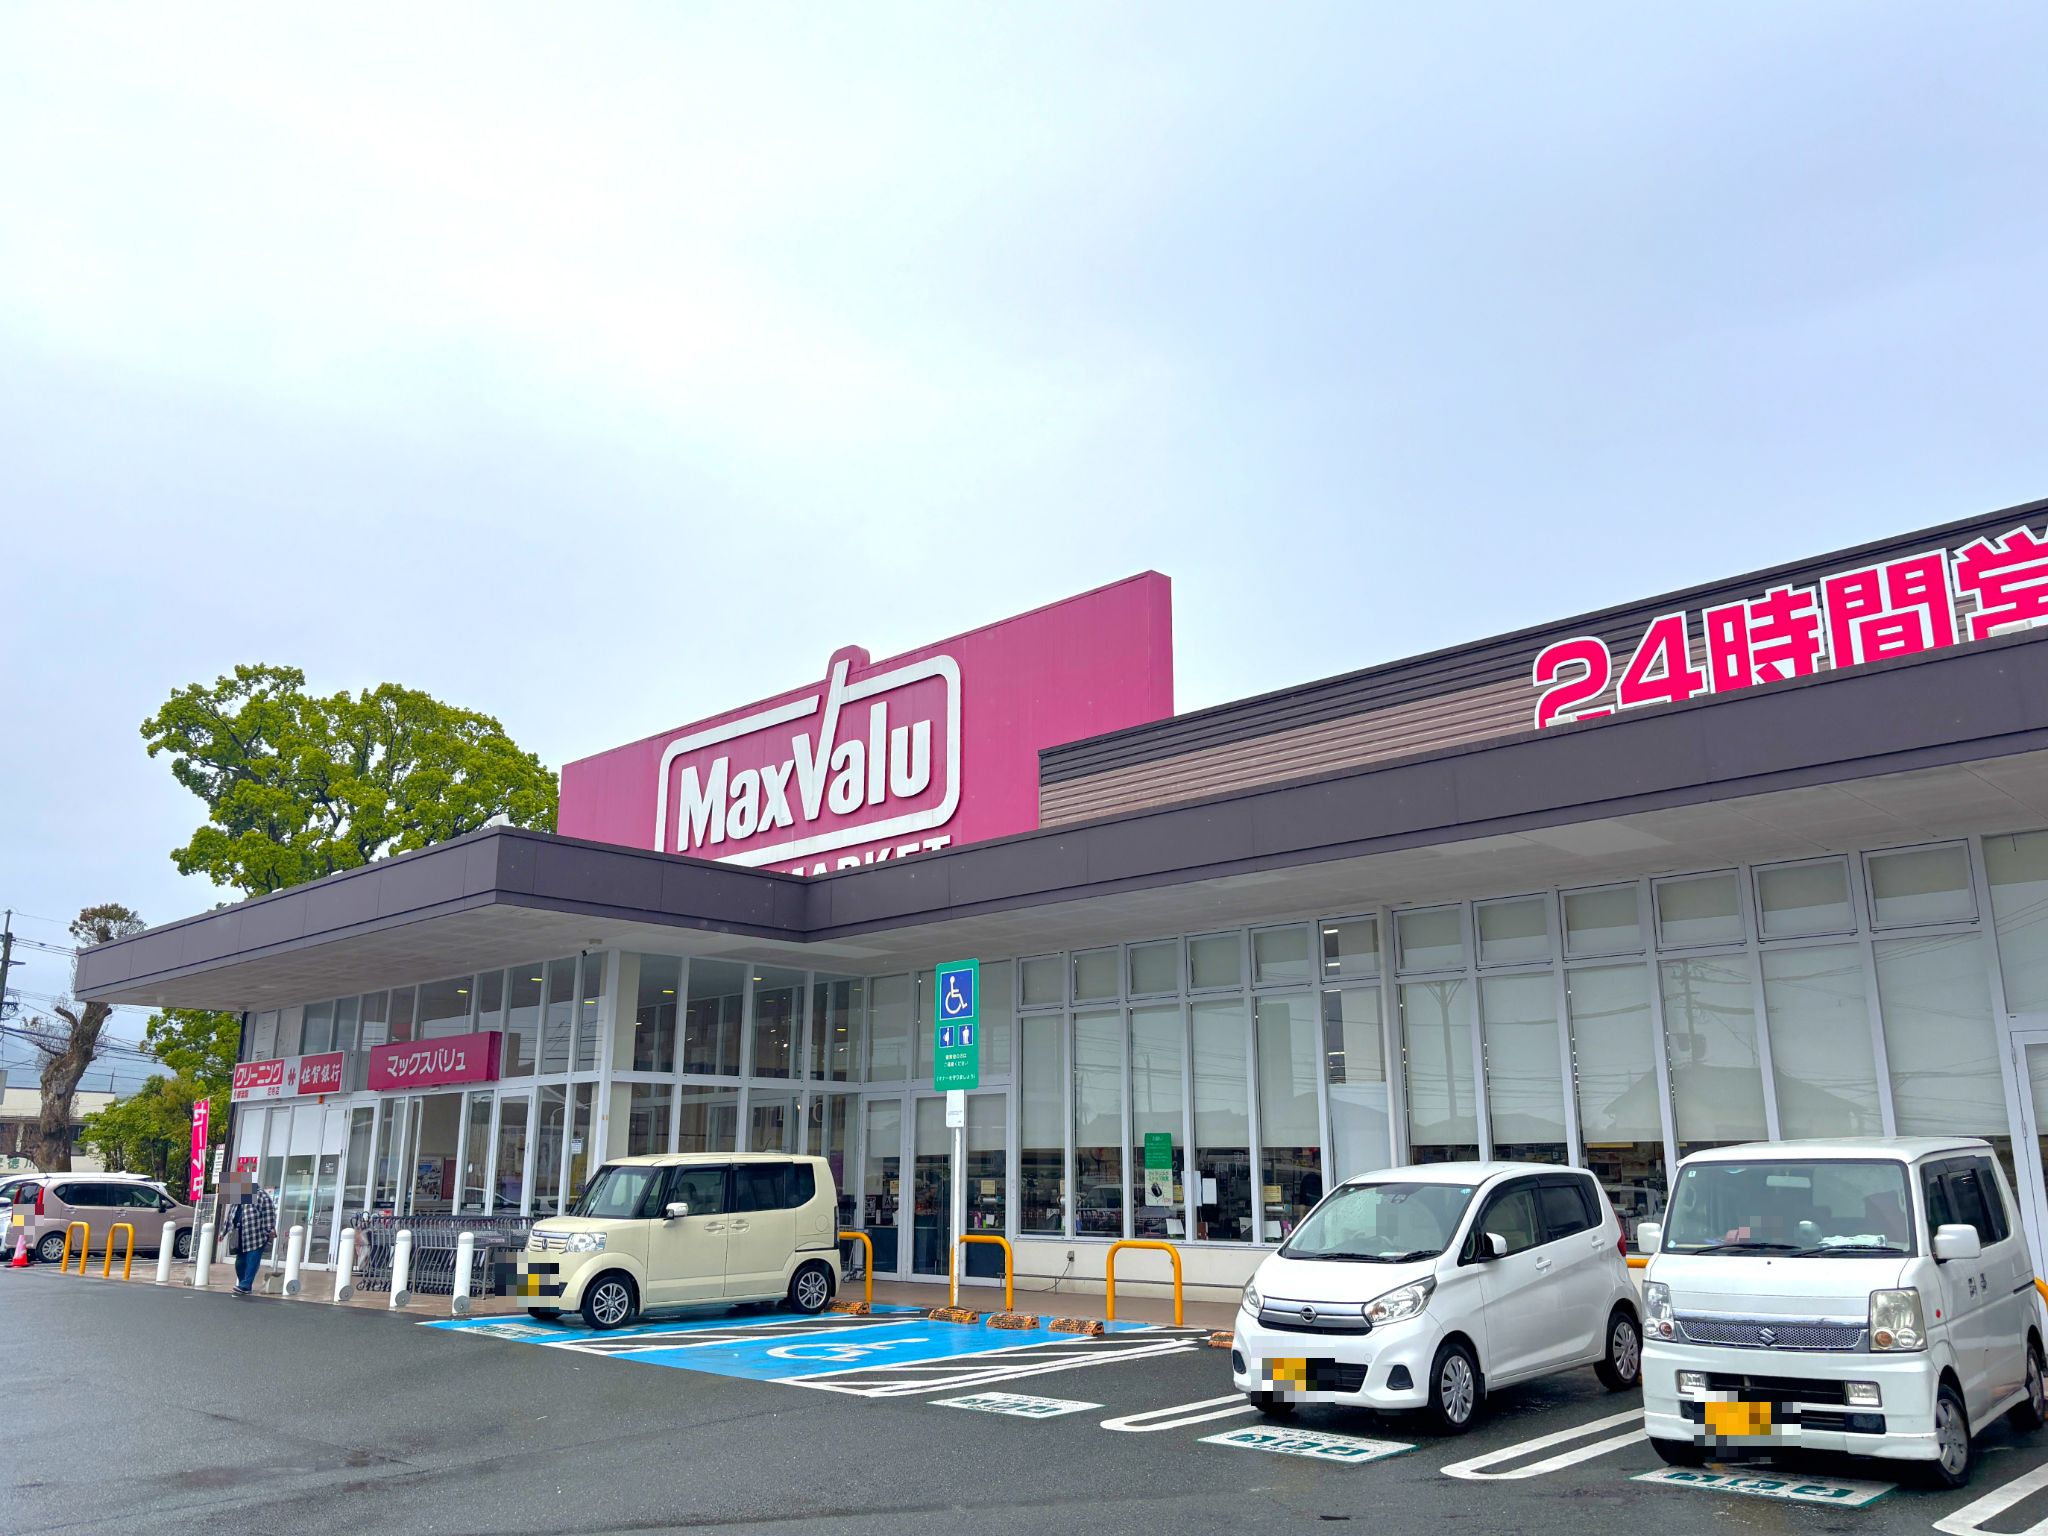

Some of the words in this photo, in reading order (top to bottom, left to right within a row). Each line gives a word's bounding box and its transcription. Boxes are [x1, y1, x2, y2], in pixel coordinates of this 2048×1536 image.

[677, 659, 932, 852] MaxValu
[236, 1061, 283, 1087] クリーニング
[301, 1063, 341, 1085] 佐賀銀行
[387, 1048, 466, 1078] マックスバリュ
